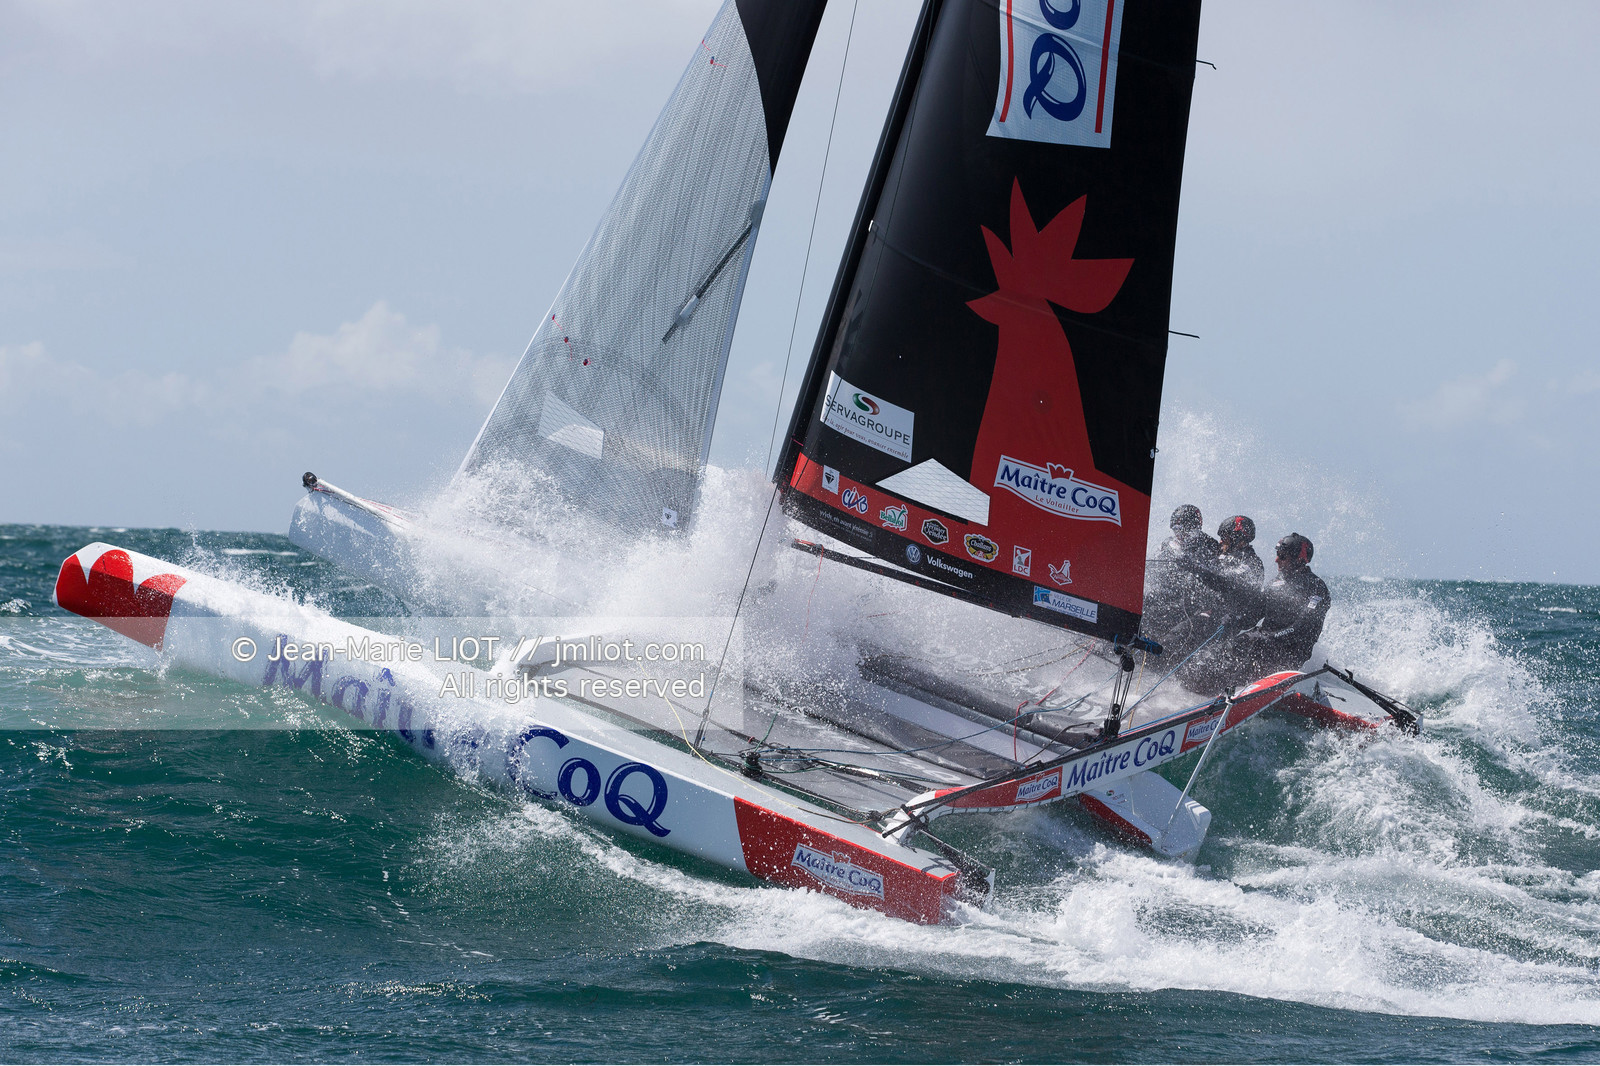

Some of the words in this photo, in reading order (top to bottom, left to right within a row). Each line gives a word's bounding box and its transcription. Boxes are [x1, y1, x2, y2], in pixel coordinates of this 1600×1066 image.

[825, 394, 911, 446] SERVAGROUPE
[1000, 464, 1067, 499] Maître
[1071, 486, 1117, 516] CoQ
[1035, 494, 1044, 503] Le
[1046, 497, 1080, 513] Volailler
[926, 555, 974, 579] Volkswagen
[1013, 565, 1029, 575] LDC
[1052, 599, 1096, 618] MARSEILLE
[1066, 751, 1131, 789] Maître
[1133, 730, 1175, 767] CoQ
[506, 725, 671, 838] CoQ
[796, 850, 845, 878] Maître
